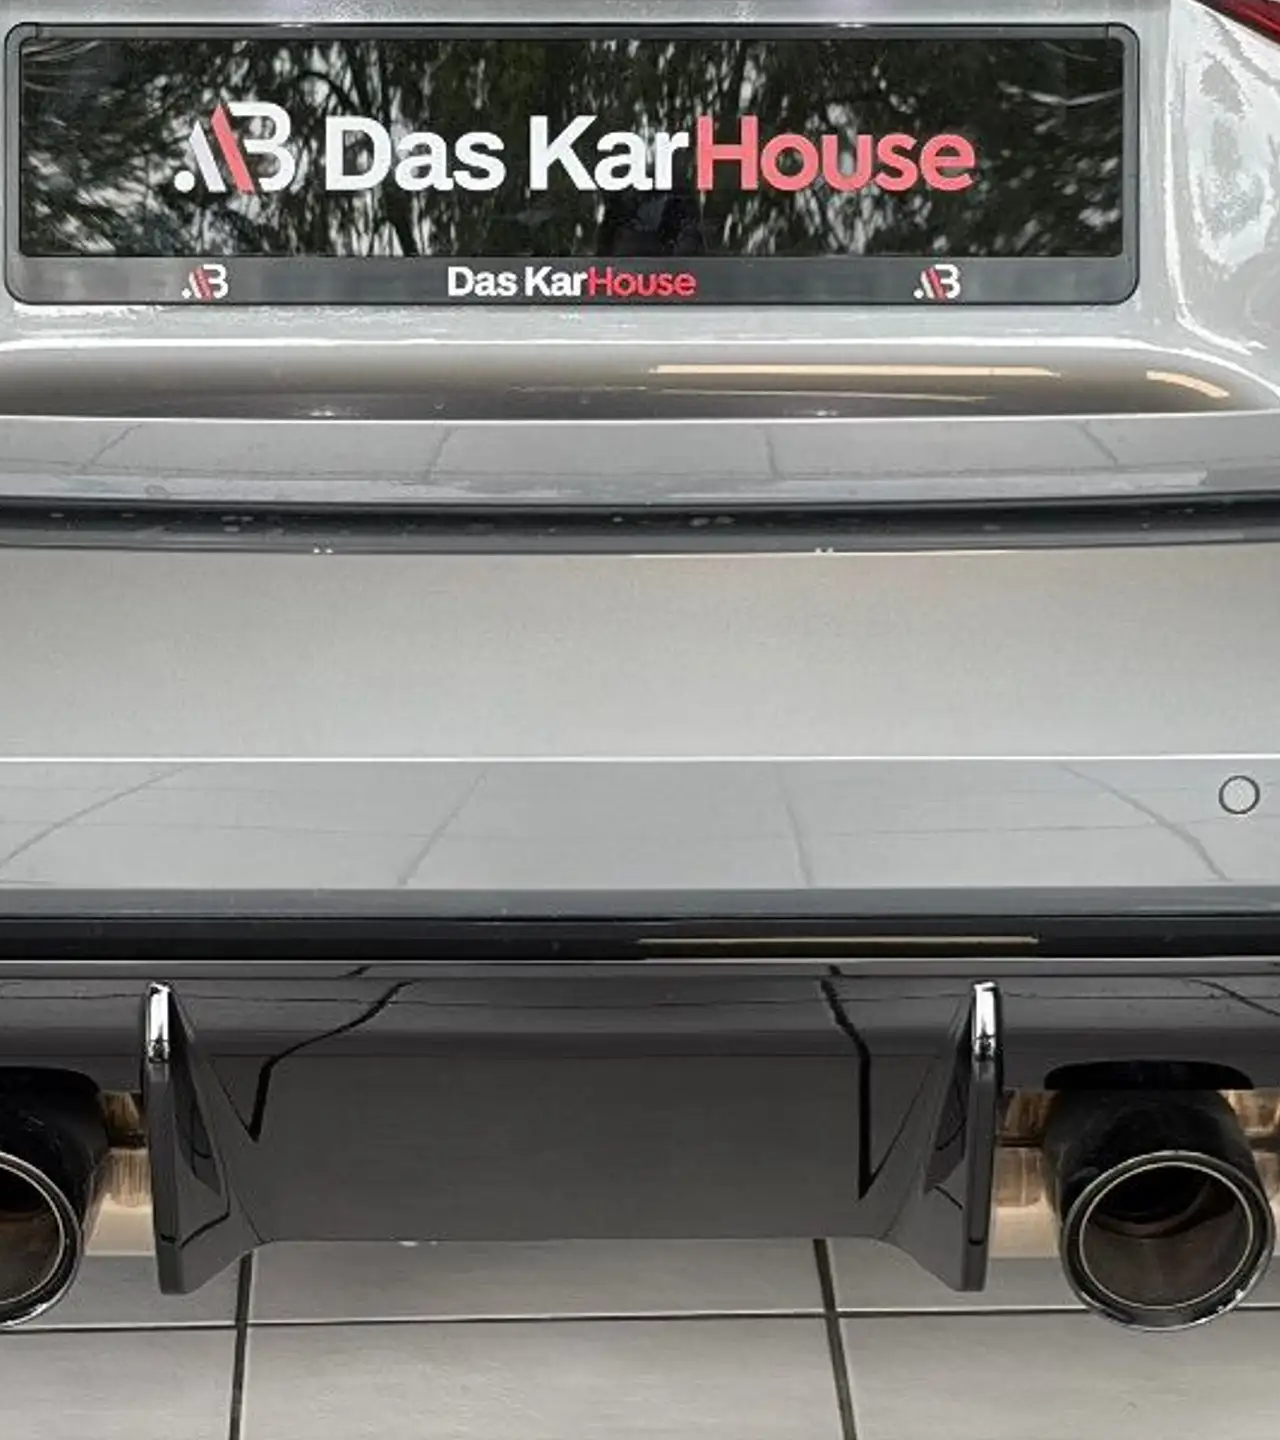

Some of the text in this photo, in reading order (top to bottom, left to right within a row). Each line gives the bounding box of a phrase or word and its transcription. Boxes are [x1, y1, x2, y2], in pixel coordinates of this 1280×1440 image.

[325, 115, 505, 192] Das
[529, 115, 975, 192] KarHouse
[447, 265, 697, 299] Das KarHouse
